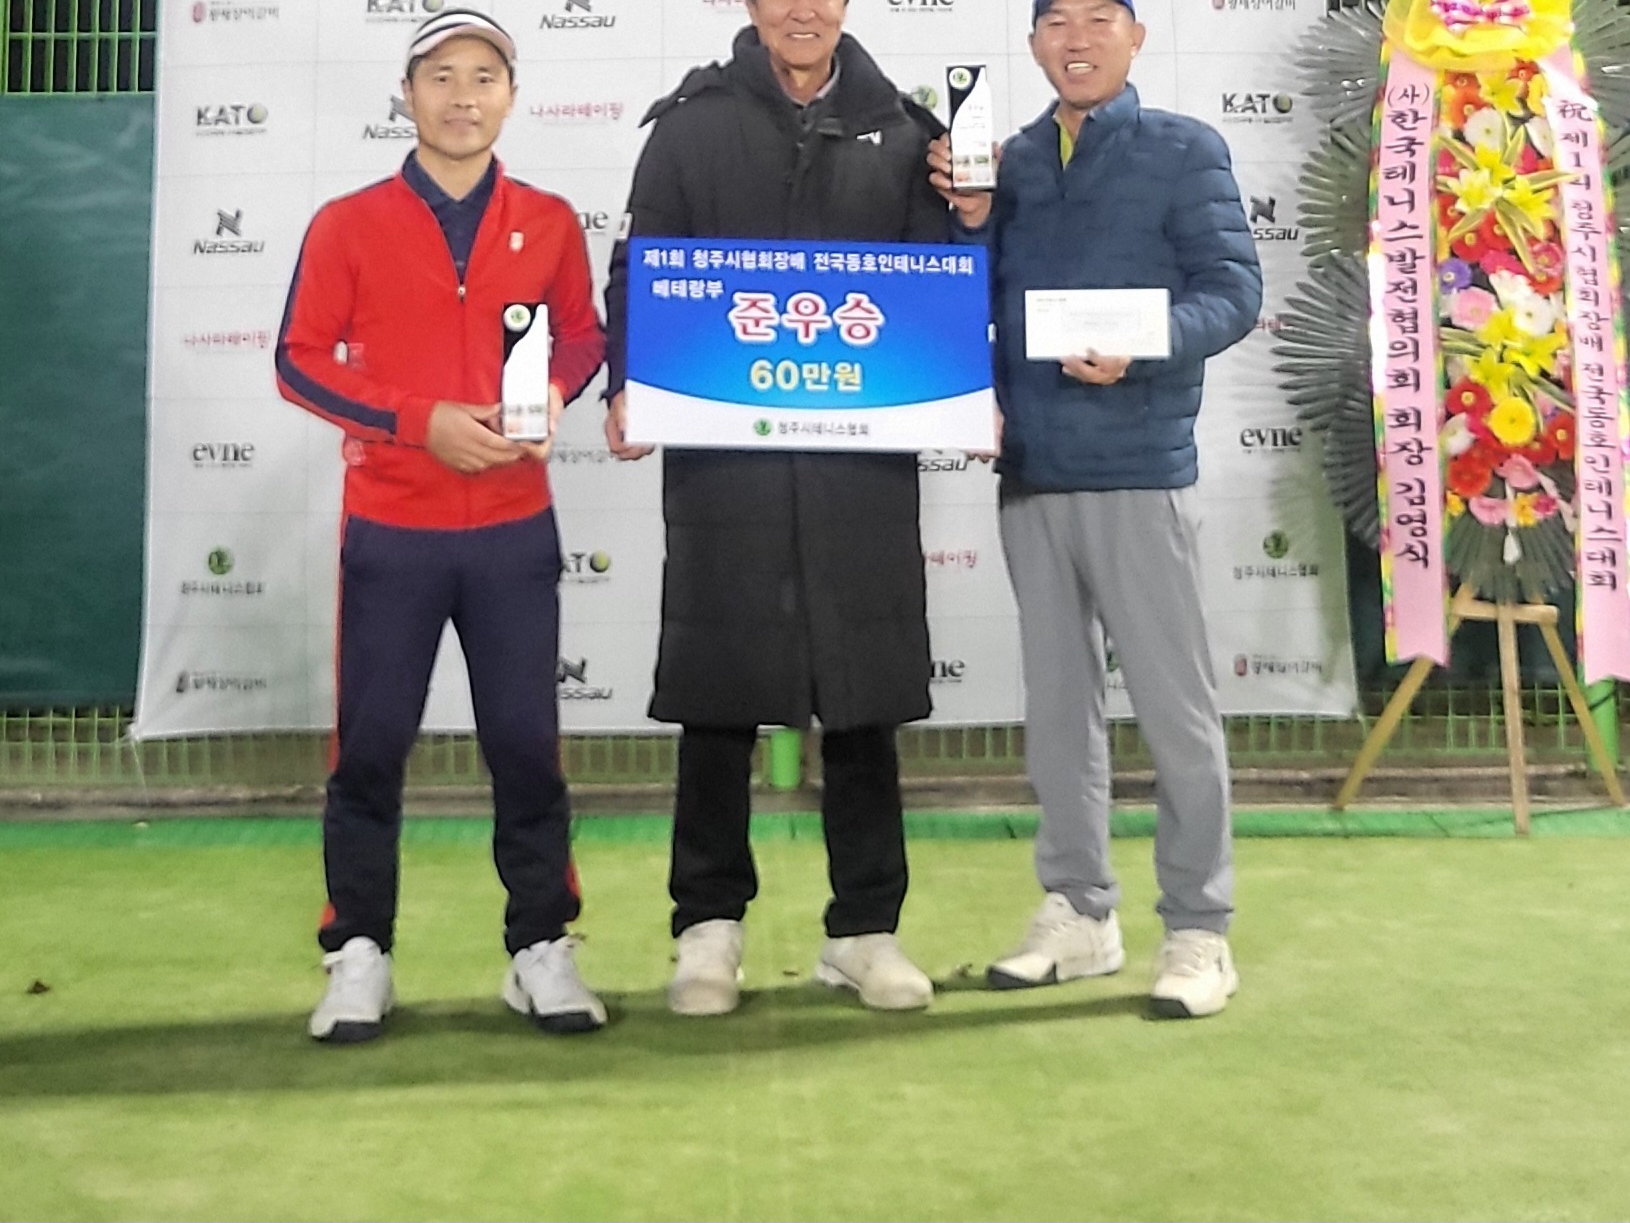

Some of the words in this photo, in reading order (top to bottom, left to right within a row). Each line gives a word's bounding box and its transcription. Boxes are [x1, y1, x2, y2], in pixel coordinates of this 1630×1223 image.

[540, 14, 616, 29] Nassau
[1222, 93, 1293, 114] KATO
[196, 104, 269, 126] KATO
[362, 124, 418, 139] Nass
[576, 210, 609, 230] ne
[1252, 227, 1299, 240] ssau
[193, 239, 265, 254] Nassau
[643, 248, 685, 269] 제1회
[692, 249, 806, 271] 청주시협회장배
[813, 251, 974, 275] 전국동호인테니스대회
[652, 279, 724, 298] 베테랑부
[728, 291, 886, 345] 준우승
[1557, 100, 1593, 122] 祝
[1583, 362, 1622, 591] 전국동호인테니스대회
[749, 358, 863, 392] 60만원
[1240, 427, 1303, 447] evne
[1387, 406, 1433, 466] 회장
[193, 442, 255, 462] evne
[917, 457, 968, 472] ssau
[931, 659, 965, 678] ne
[559, 687, 613, 699] ssau
